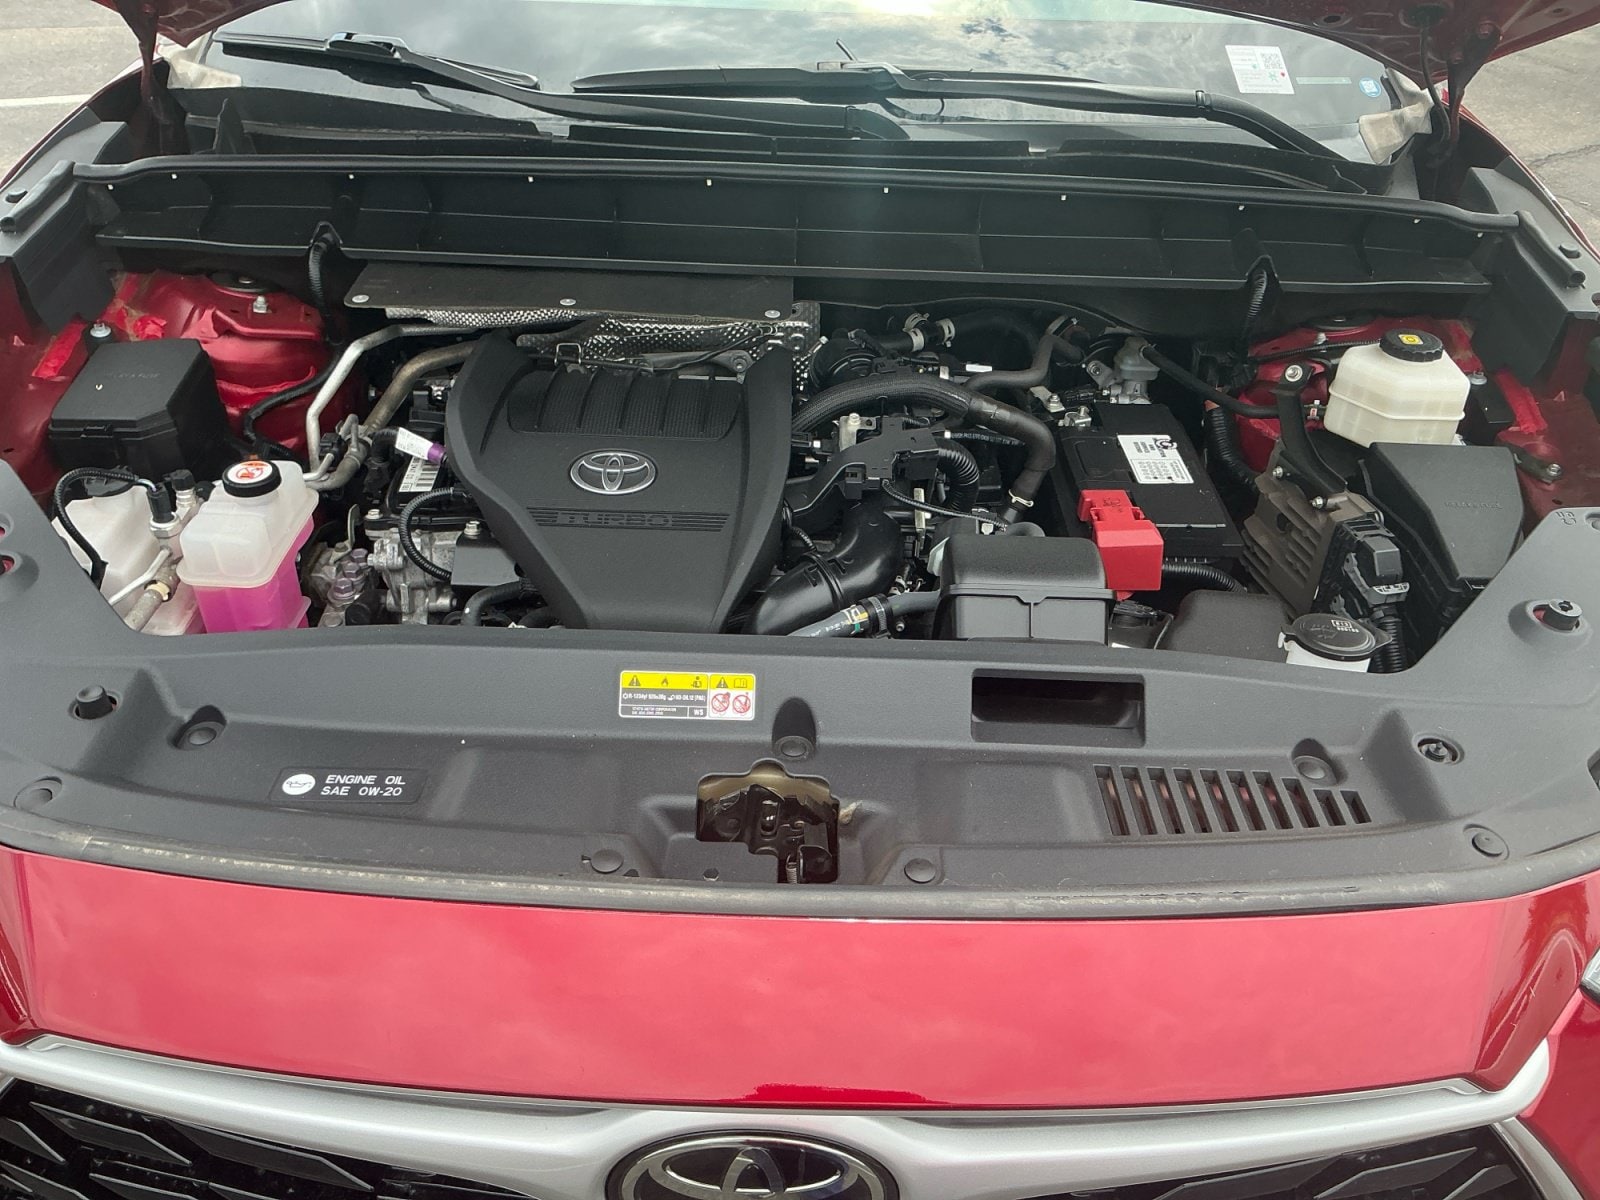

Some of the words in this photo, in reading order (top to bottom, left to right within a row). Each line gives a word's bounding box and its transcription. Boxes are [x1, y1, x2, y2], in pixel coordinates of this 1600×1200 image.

[558, 511, 671, 526] TURBO
[325, 774, 378, 785] ENGINE
[384, 775, 406, 785] OIL
[320, 786, 351, 796] SAE
[358, 786, 403, 797] 0W-20
